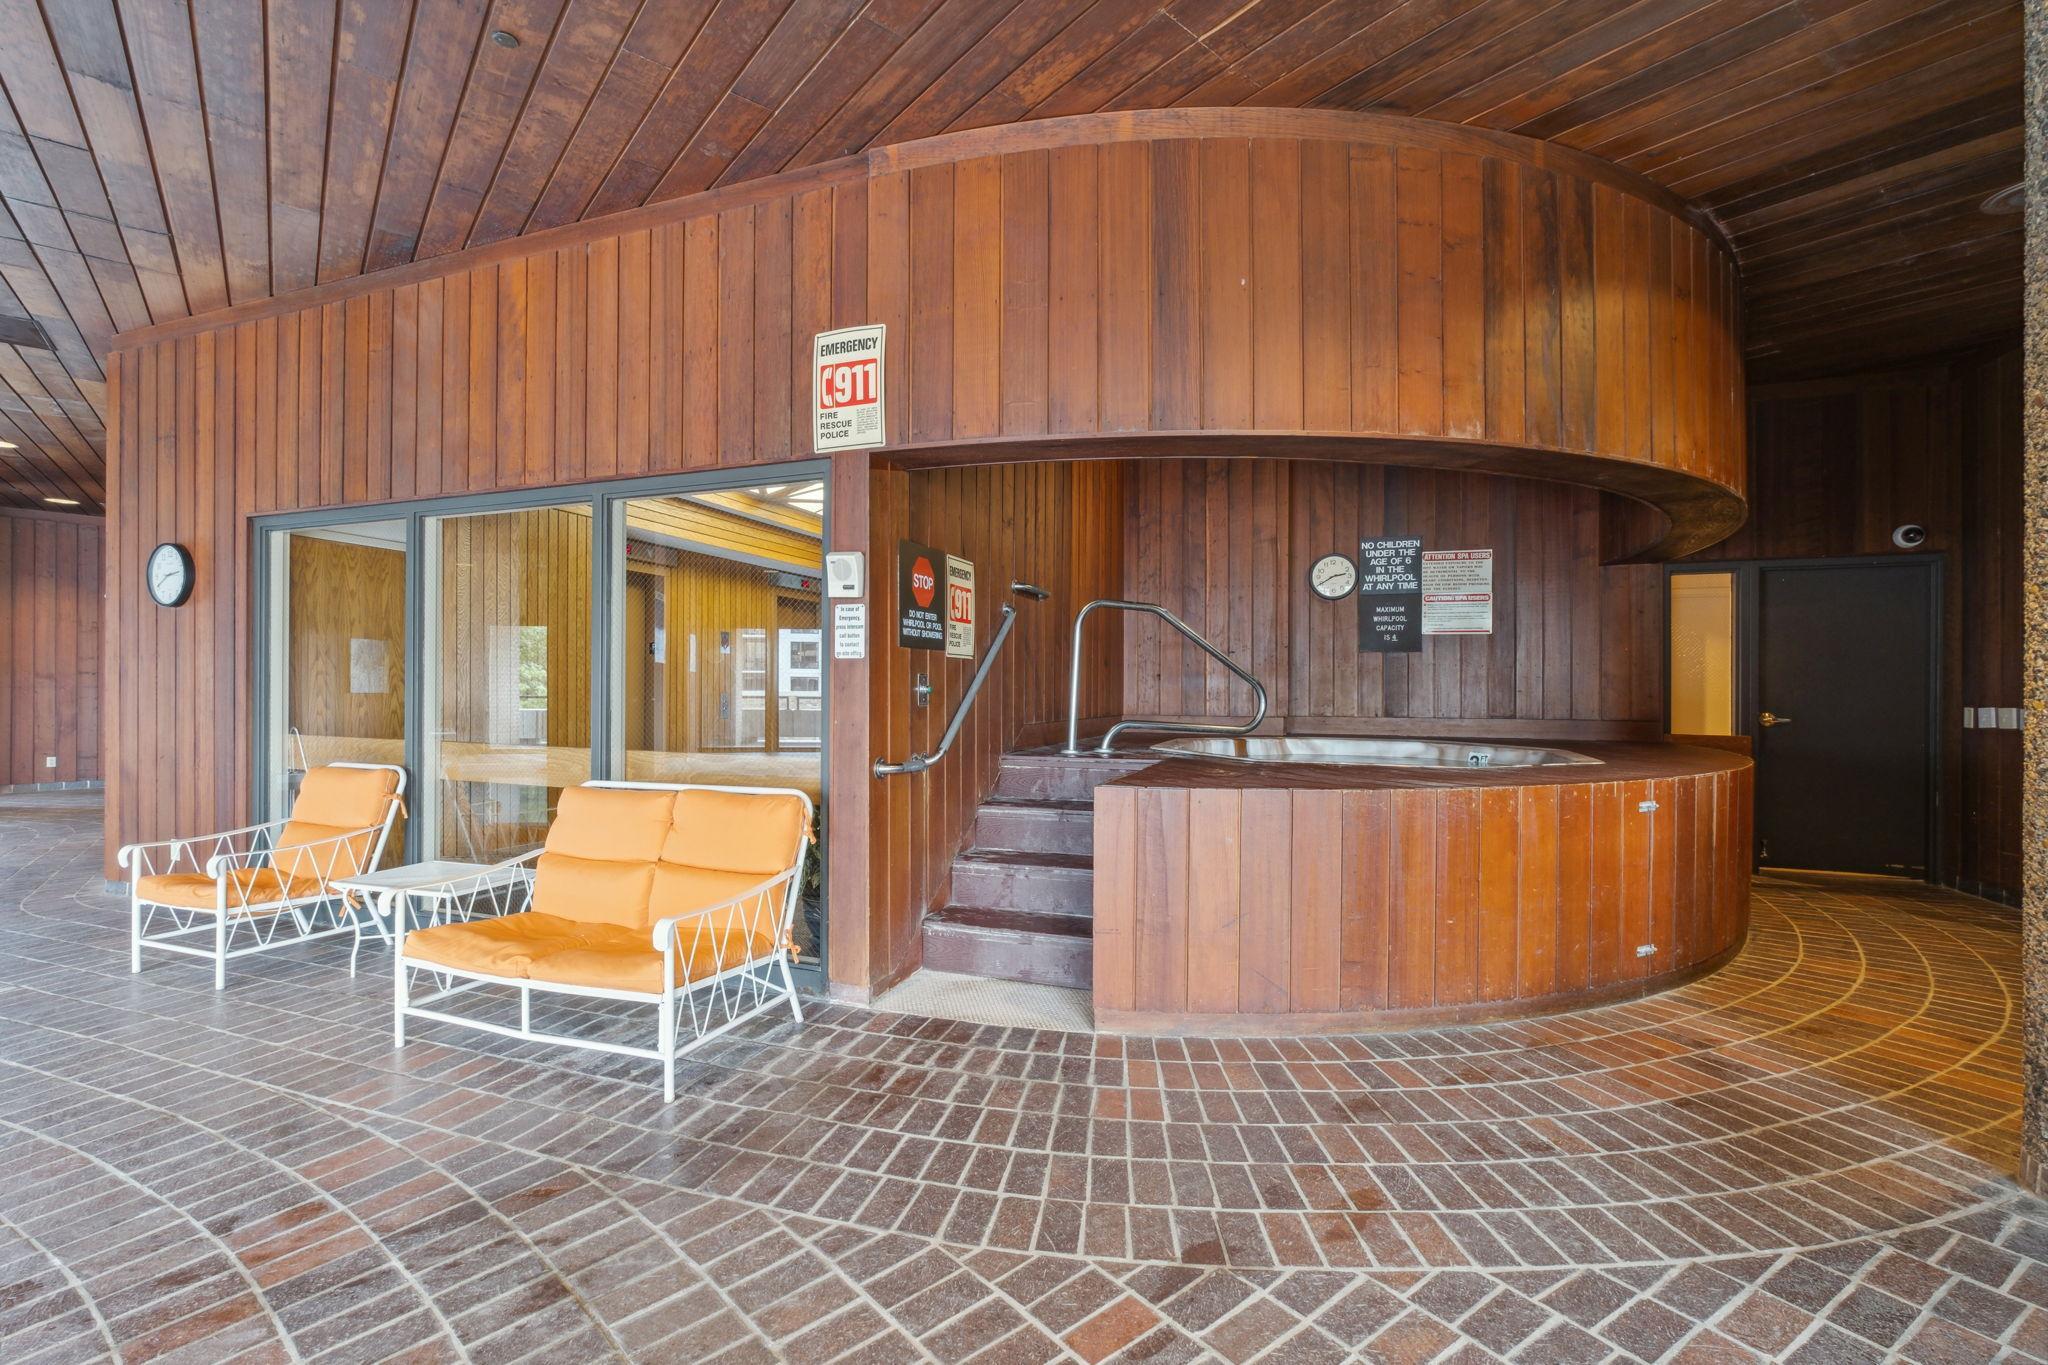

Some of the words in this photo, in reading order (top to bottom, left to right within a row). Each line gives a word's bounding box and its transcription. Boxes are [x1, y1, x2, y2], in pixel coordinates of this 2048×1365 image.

[820, 337, 879, 357] EMERGENCY
[835, 363, 877, 403] 911
[820, 412, 838, 420] FIRE
[820, 420, 852, 430] RESCUE
[820, 430, 849, 440] POLICE
[1361, 542, 1375, 550] NO
[1377, 540, 1420, 549] CHILDREN
[1365, 550, 1396, 558] UNDER
[1399, 548, 1416, 556] THE
[1424, 553, 1456, 561] ATTENTION
[1370, 558, 1388, 566] AGE
[1390, 557, 1404, 565] OF
[949, 565, 972, 581] EMERGENCY
[1376, 566, 1385, 574] IN
[913, 573, 934, 591] STOP
[1365, 574, 1416, 582] WHIRLPOOL
[1363, 583, 1374, 591] AT
[1397, 581, 1418, 589] TIME
[954, 589, 972, 620] 911
[908, 609, 916, 618] DO
[916, 611, 925, 619] NOT
[925, 612, 938, 621] ENTER
[902, 618, 926, 629] WHIRLPOOL
[932, 623, 943, 631] POOL
[902, 627, 921, 637] WITHOUT
[921, 630, 943, 640] SHOWERING
